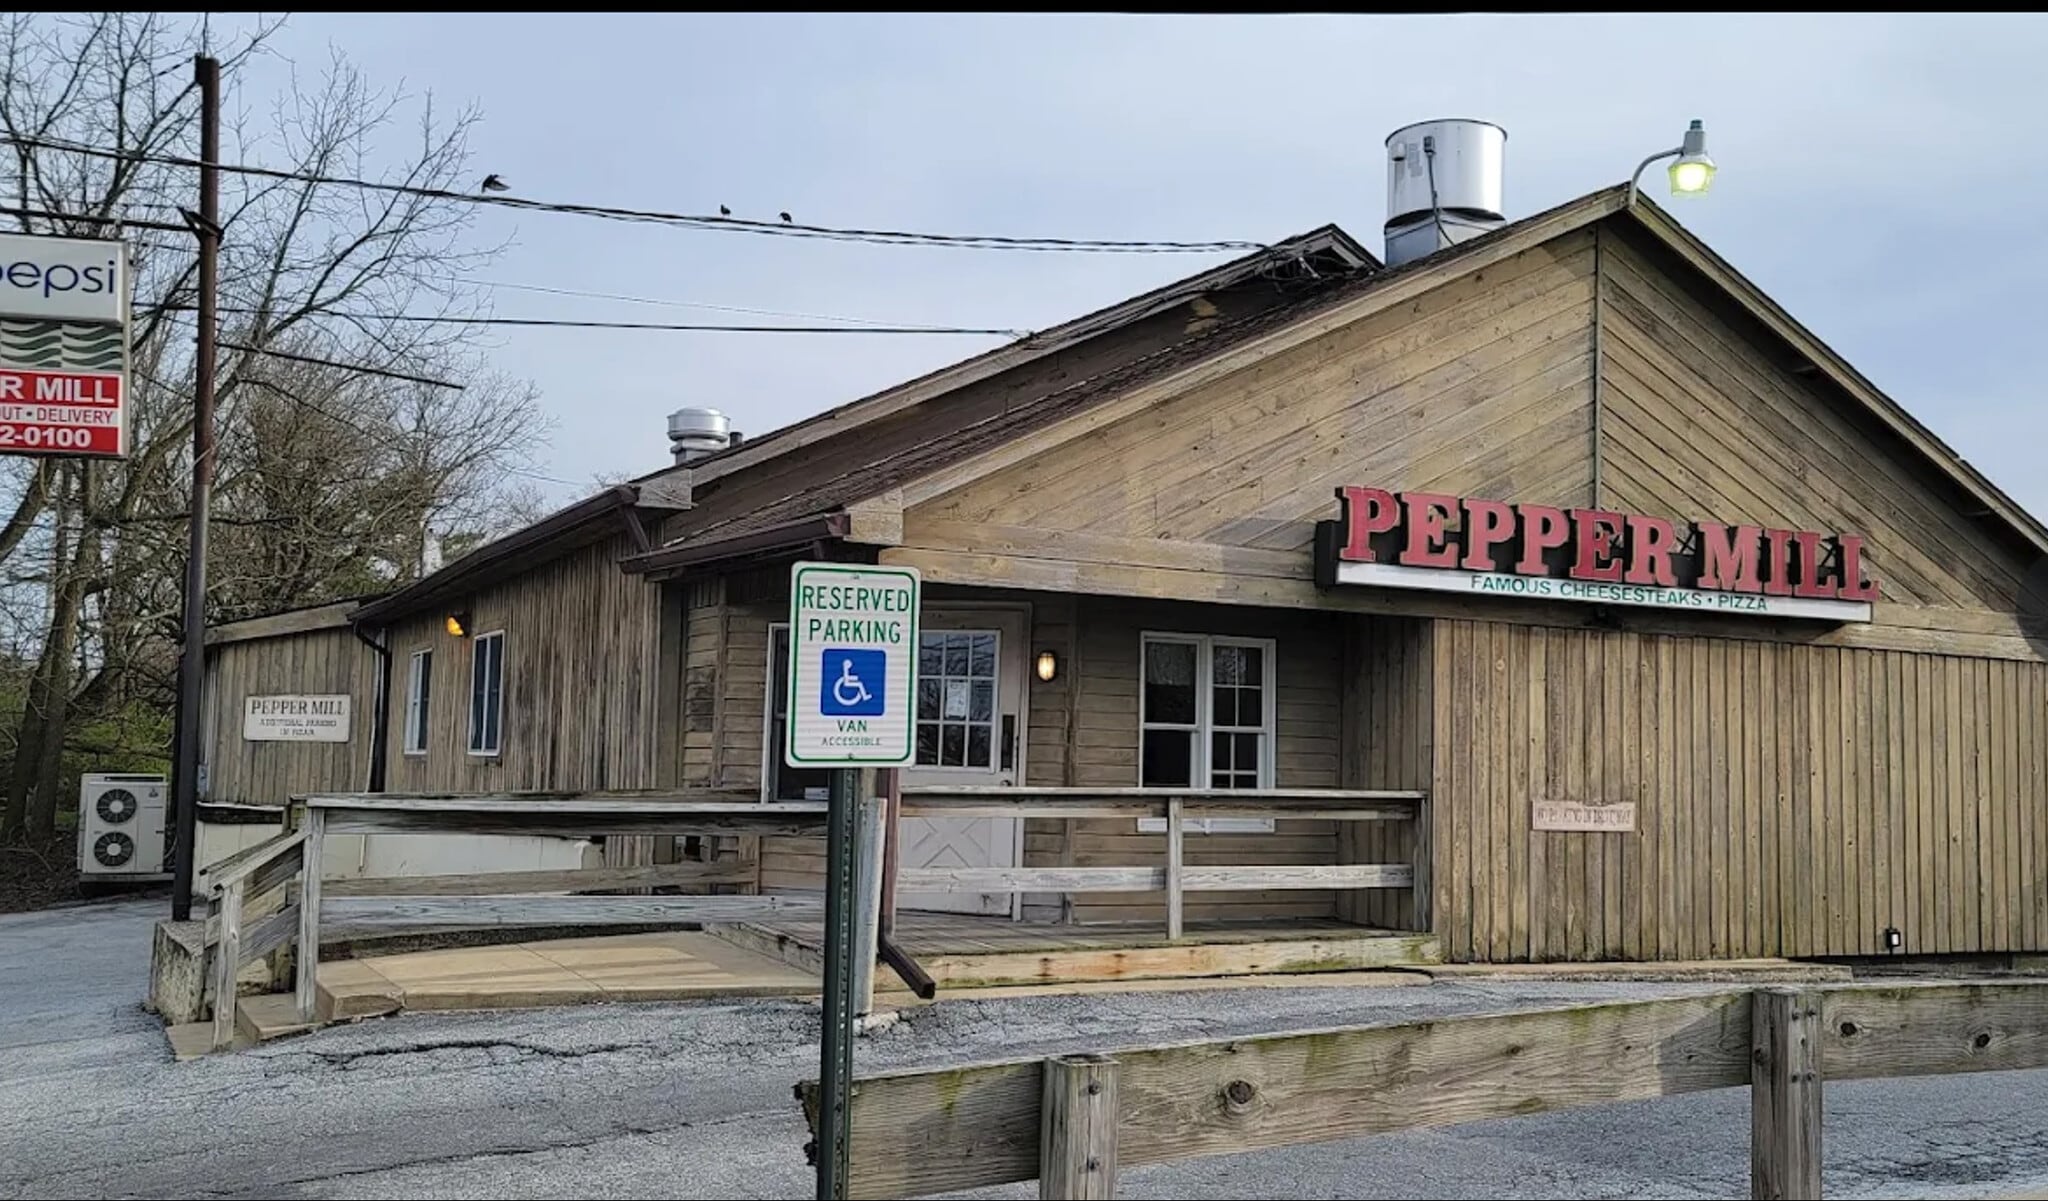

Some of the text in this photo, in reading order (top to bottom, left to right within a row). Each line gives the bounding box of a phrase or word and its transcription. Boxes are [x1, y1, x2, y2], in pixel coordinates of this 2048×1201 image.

[0, 260, 115, 298] epsi
[36, 377, 115, 404] MILL
[0, 406, 114, 424] UT DELIVERY
[1341, 486, 1880, 602] PEPPER MILL
[802, 585, 909, 612] RESERVED
[1471, 575, 1768, 612] FAMOUS CHEESESTEAKS PIZZA
[809, 618, 901, 644] PARKING
[251, 700, 345, 715] PEPPER MILL
[837, 719, 867, 732] VAN
[822, 737, 882, 747] ACCESSIBLE
